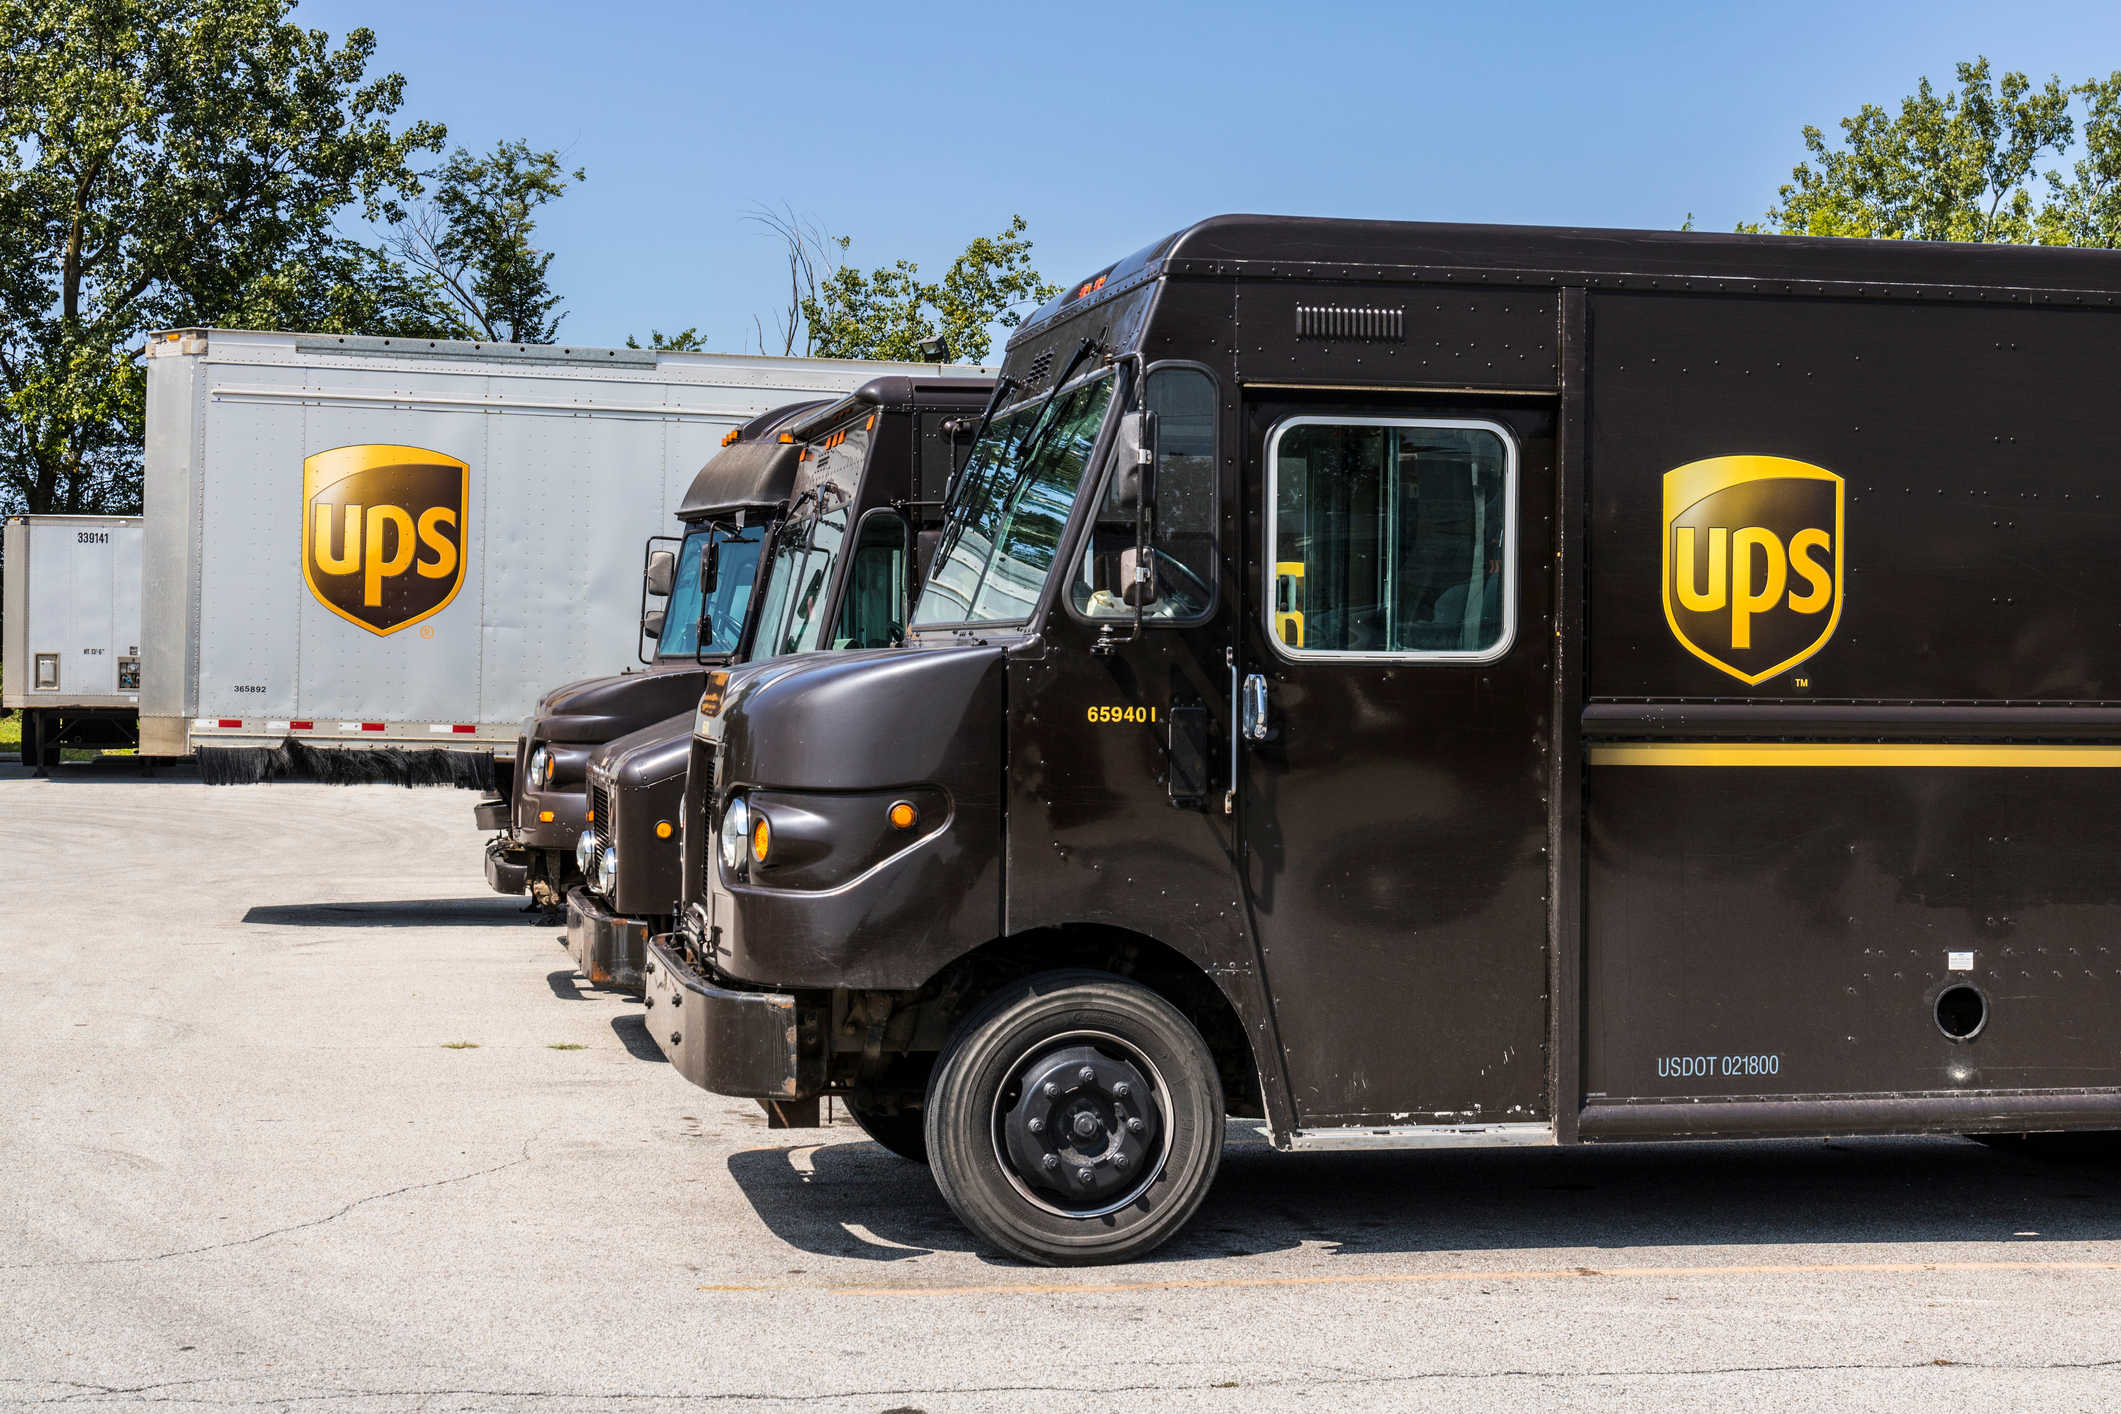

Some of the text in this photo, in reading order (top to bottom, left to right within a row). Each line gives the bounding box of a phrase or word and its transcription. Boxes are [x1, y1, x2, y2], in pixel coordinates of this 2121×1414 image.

[77, 532, 109, 544] 339141
[1795, 678, 1808, 687] TM
[233, 685, 267, 693] 365892
[1087, 705, 1156, 723] 659401
[1658, 1055, 1779, 1077] USDOT 021800
